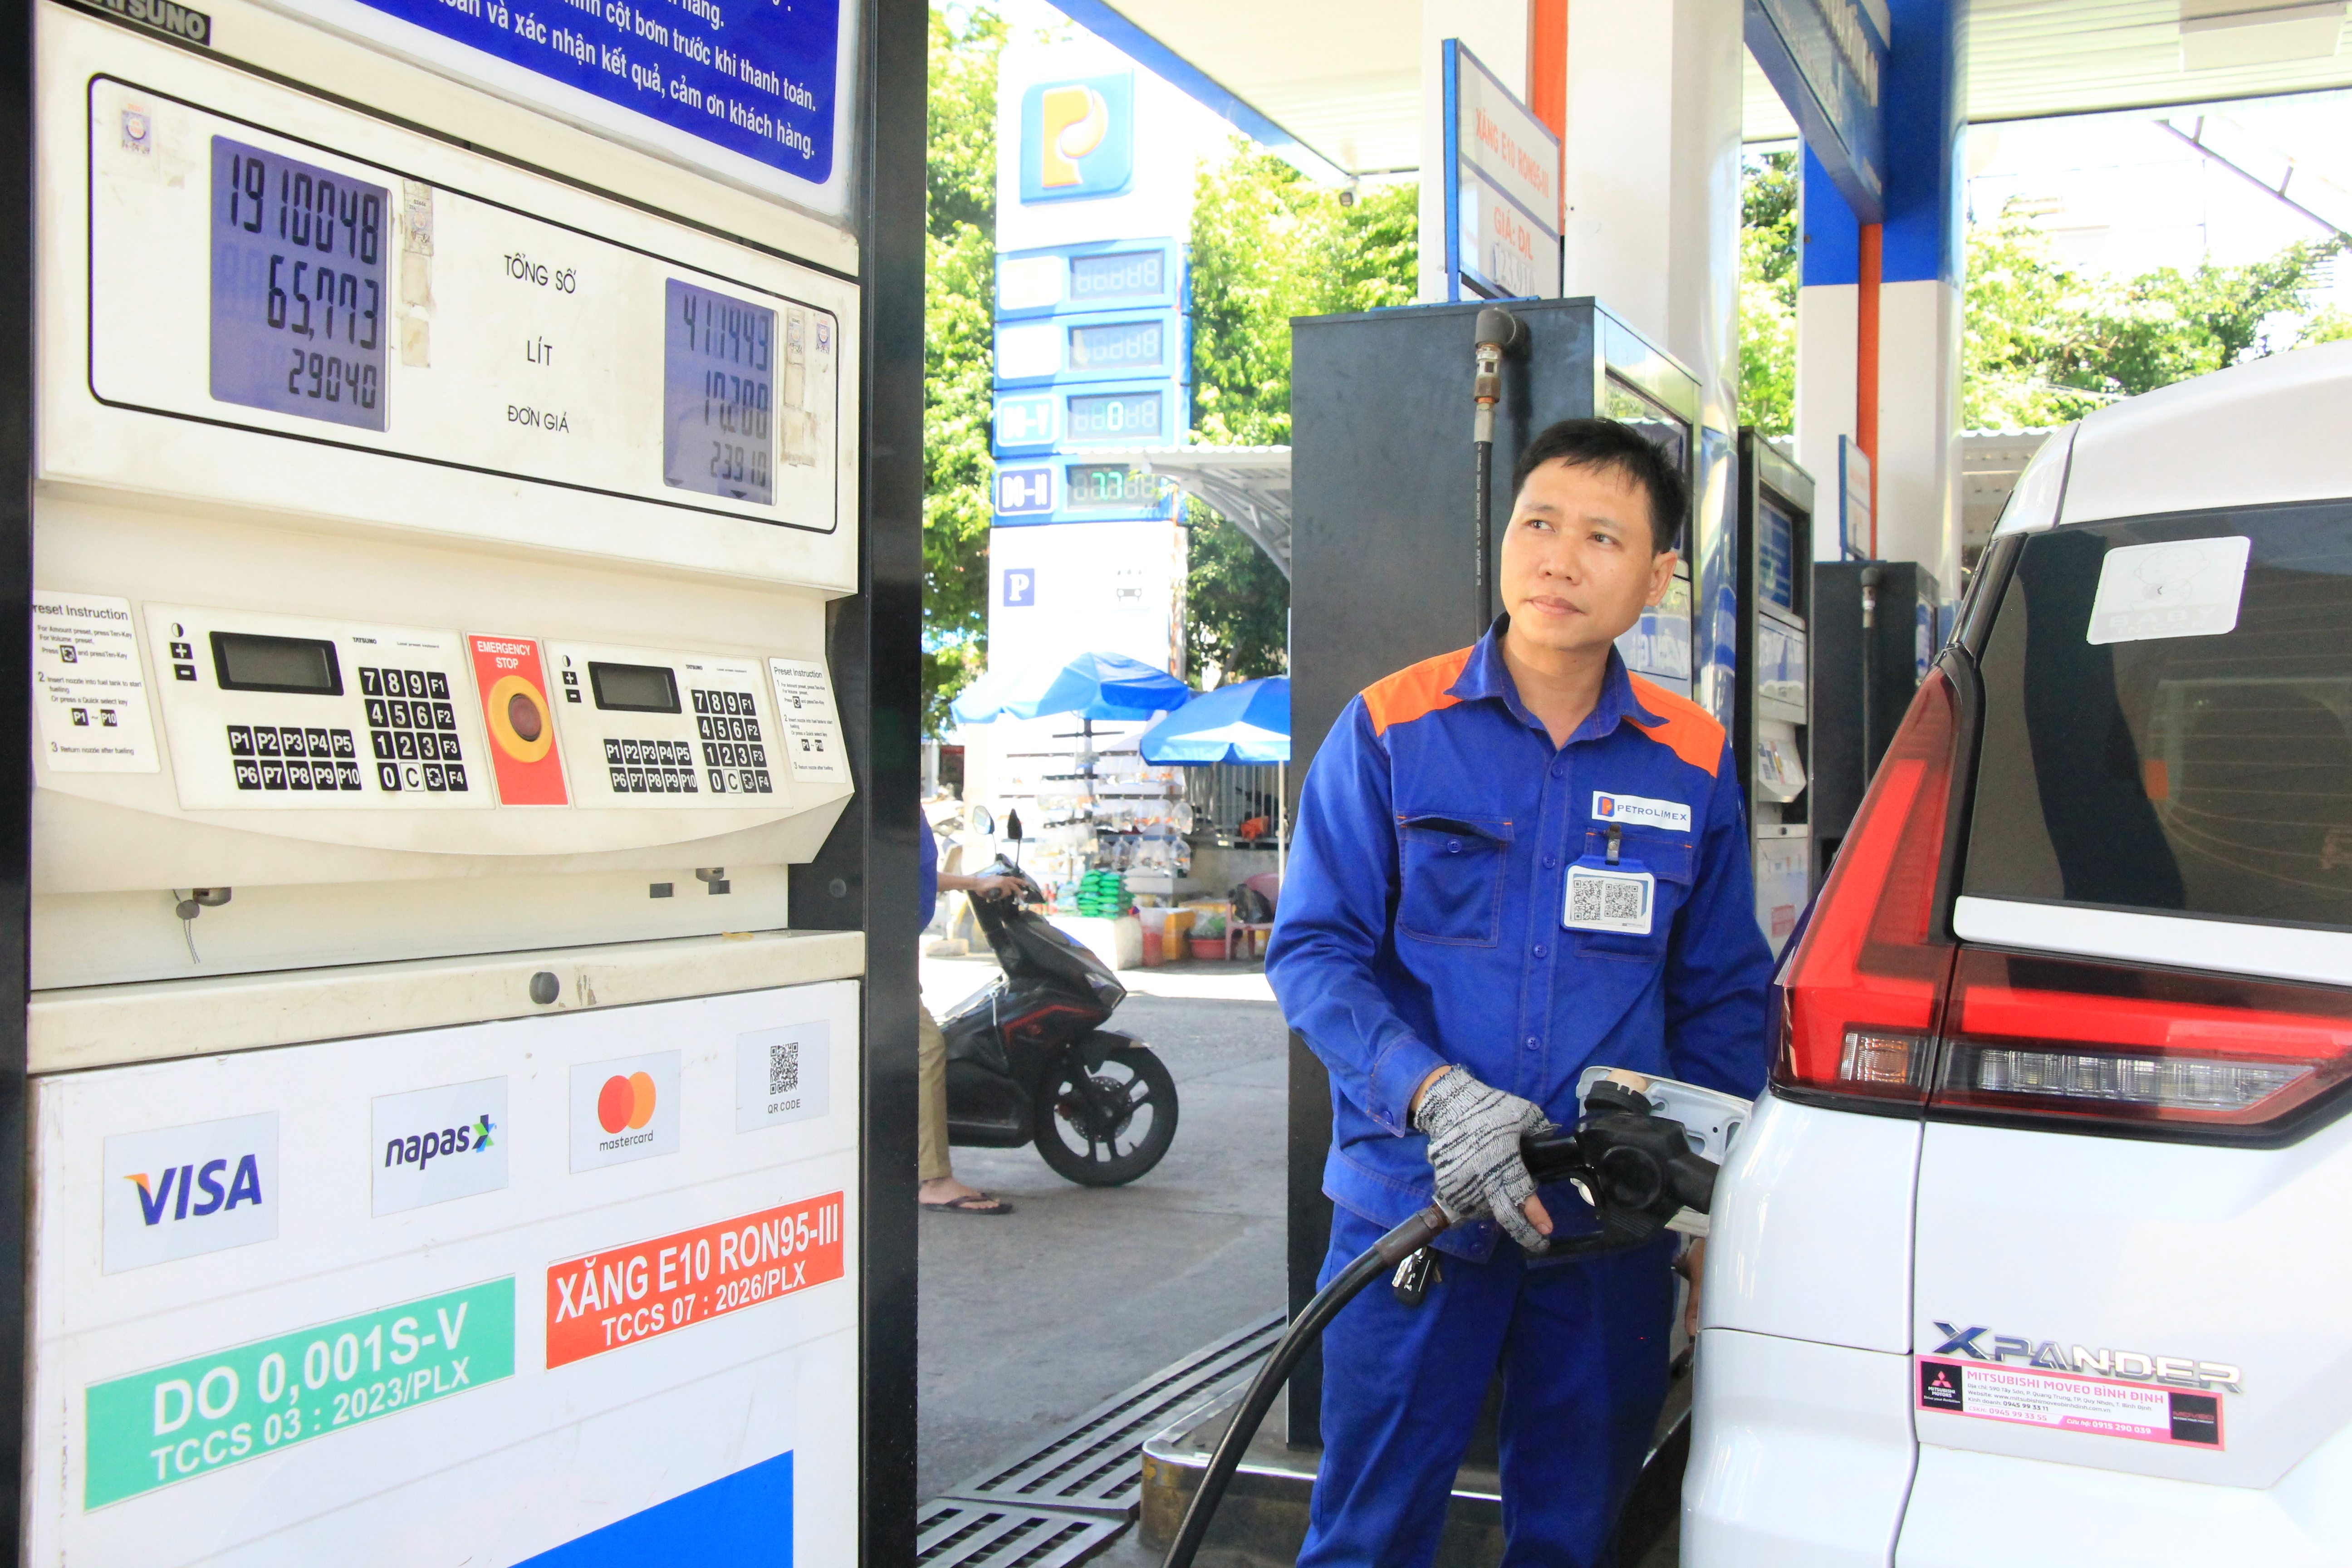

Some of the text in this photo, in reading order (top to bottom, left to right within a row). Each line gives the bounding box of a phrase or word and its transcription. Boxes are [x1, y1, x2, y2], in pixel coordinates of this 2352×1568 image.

[606, 1, 631, 32] cột
[636, 10, 668, 47] bơm
[673, 28, 710, 65] trước
[715, 46, 736, 77] khi
[740, 59, 779, 95] thanh
[784, 78, 816, 112] toán.
[487, 0, 509, 29] và
[514, 12, 547, 44] xác
[553, 28, 595, 65] nhận
[602, 44, 627, 78] kết
[632, 63, 665, 99] quả,
[671, 75, 701, 109] cảm
[707, 94, 725, 119] ơn
[730, 99, 772, 138] khách
[777, 119, 815, 160] hàng.
[1476, 107, 1498, 153] XĂNG
[1502, 132, 1515, 168] E10
[230, 153, 379, 265] 1910048
[1494, 206, 1515, 246] GIÁ:
[504, 252, 576, 294] TỔNG SỐ
[527, 336, 553, 366] LÍT
[289, 348, 377, 409] 29040
[508, 405, 569, 433] ĐƠN GIÁ
[1009, 574, 1029, 601] P
[32, 604, 128, 620] reset Instruction
[2109, 607, 2218, 627] BABY
[477, 641, 530, 656] EMERGENCY
[496, 657, 519, 669] STOP
[774, 666, 823, 678] Preset Instruction
[363, 672, 445, 694] 7 8 9 F1
[695, 694, 753, 712] 7 8 9 F1
[372, 704, 452, 725] 4 5 6 F2
[701, 720, 759, 738] 4 5 6 F2
[231, 732, 353, 752] P1 P2 P3 P4 P5
[377, 735, 457, 756] 1 2 3 F3
[606, 747, 690, 761] P1 P2 P3 P4 P5
[707, 747, 764, 764] 1 2 3 F3
[237, 767, 360, 785] P6 P7 P8 P9 P10
[384, 767, 463, 788] 0 C F4
[612, 774, 696, 789] P6 P7 P8 P9 P10
[712, 773, 769, 790] 0 C F4
[1617, 805, 1687, 821] PETROLIMEX
[768, 1098, 800, 1114] QR CODE
[385, 1124, 470, 1170] napas
[599, 1130, 654, 1151] mastercard
[122, 1153, 262, 1226] VISA
[555, 1203, 838, 1323] XĂNG E10 RON95-III
[602, 1260, 806, 1346] TCCS 07 2026/PLX
[1932, 1320, 2243, 1393] XPANDER
[154, 1302, 469, 1436] DO 0,001S-V
[1927, 1386, 1956, 1394] MITSUBISHI
[1967, 1390, 1993, 1398] Website:
[1968, 1371, 2163, 1404] MITSUBISHI MOVEO BÌNH ĐỊNH
[150, 1356, 471, 1480] TCCS 03 2023/PLX
[1989, 1407, 2010, 1416] 0945
[2080, 1420, 2092, 1428] hộ:
[2092, 1421, 2113, 1430] 0915
[2115, 1424, 2133, 1432] 290
[2134, 1426, 2151, 1435] 039
